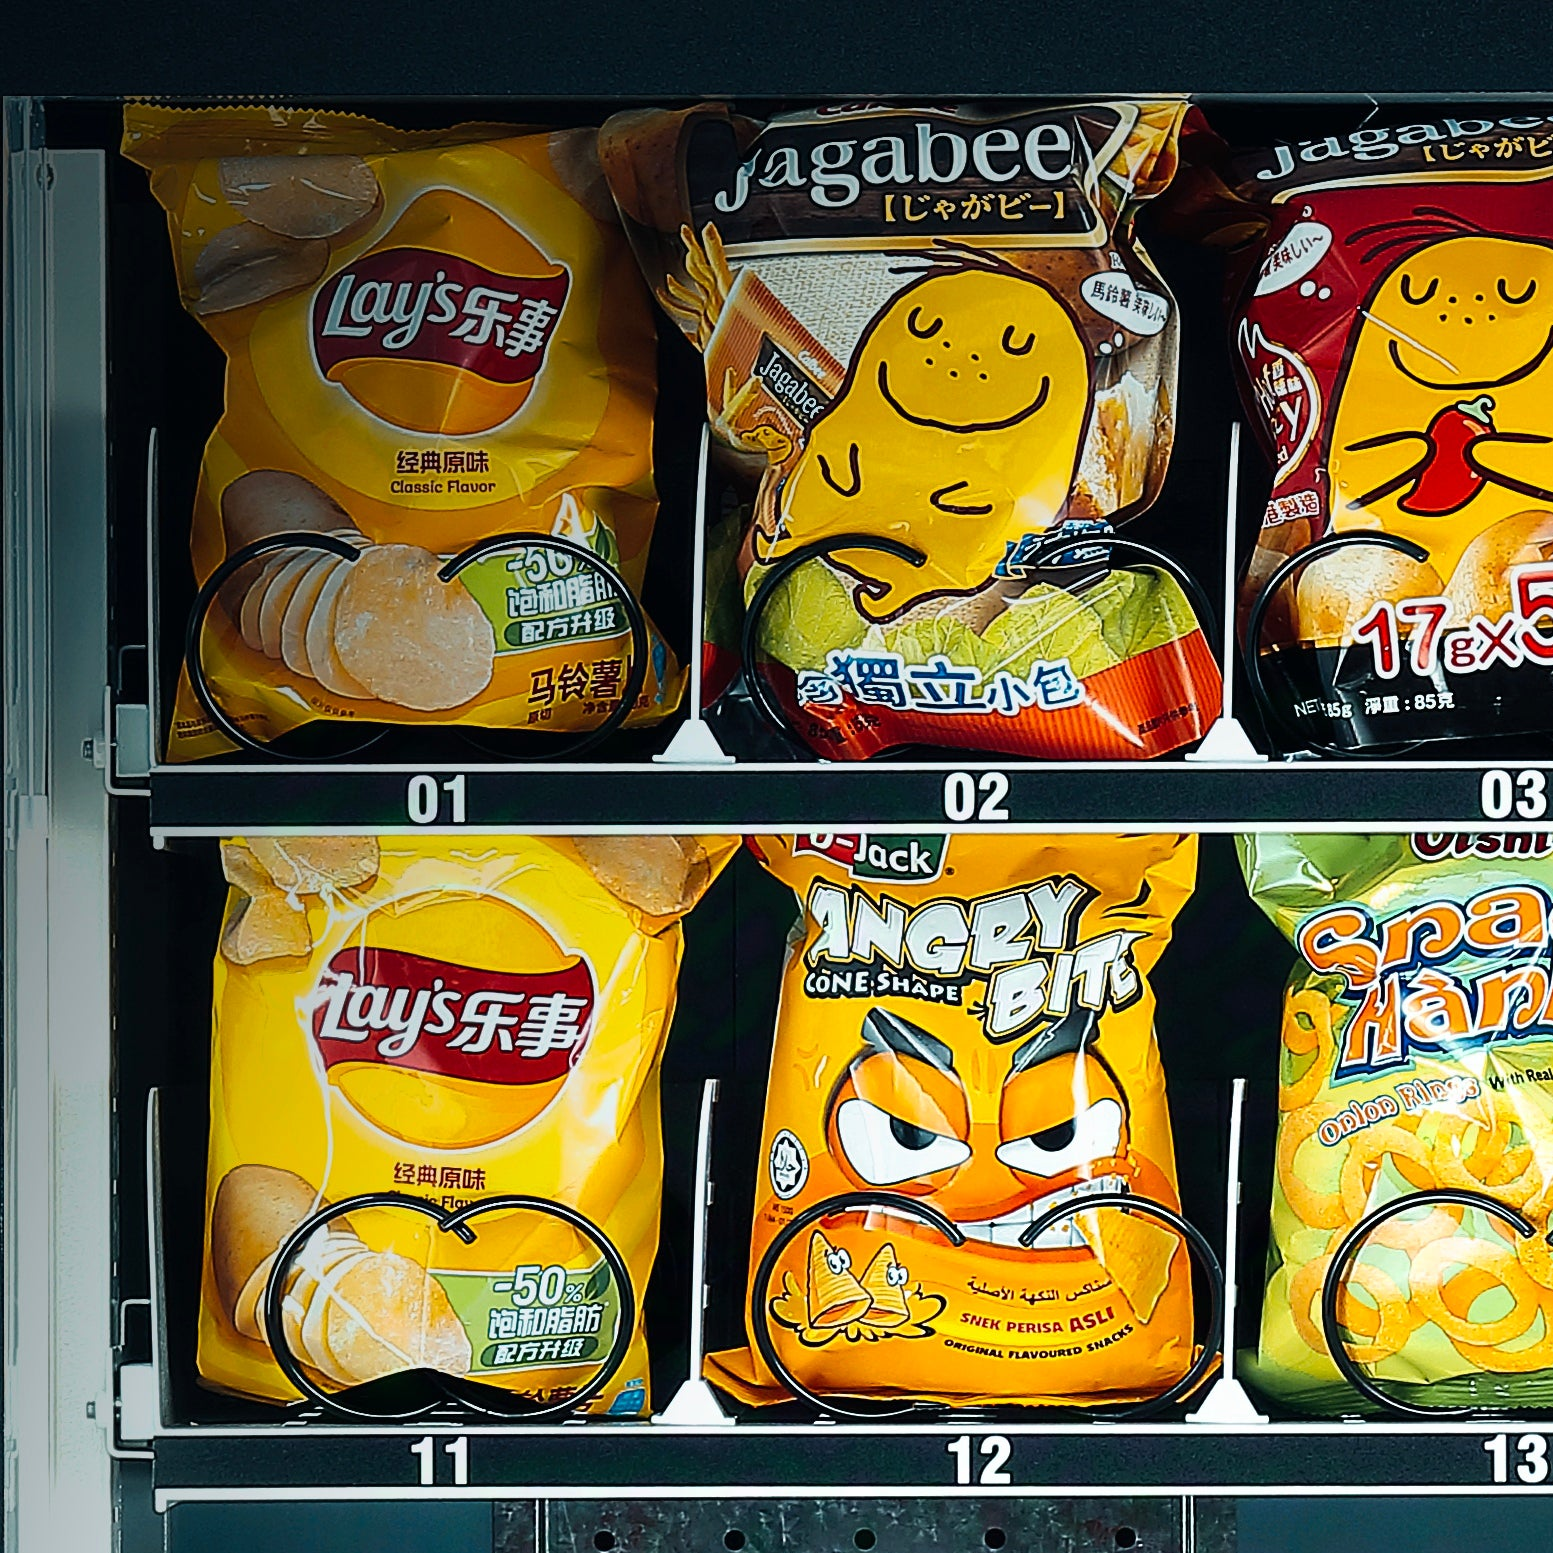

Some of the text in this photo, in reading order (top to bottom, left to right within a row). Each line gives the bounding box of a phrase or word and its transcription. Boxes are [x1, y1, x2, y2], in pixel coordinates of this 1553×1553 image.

[714, 122, 1075, 214] Jagabee
[321, 270, 558, 358] Lay's 乐事
[397, 450, 489, 474] 经典原味
[391, 480, 496, 494] Classic Flavor
[521, 608, 615, 643] 配方升级
[409, 775, 465, 823] 01
[945, 772, 1008, 820] 02
[1482, 770, 1546, 818] 03
[808, 878, 1084, 976] ANGRY
[320, 978, 587, 1057] Lay's 乐事
[1319, 1096, 1396, 1147] Onion
[1400, 1075, 1479, 1120] Rings
[394, 1163, 486, 1191] 经典原味
[493, 1266, 584, 1307] -50%
[488, 1305, 602, 1339] 饱和脂肪
[943, 1323, 1134, 1360] ORIGINAL FLAVOURED SNACKS
[960, 1306, 1116, 1334] SNEK PERISA ASLI
[495, 1338, 584, 1364] 配方升级
[412, 1437, 467, 1484] 11
[948, 1436, 1010, 1484] 12
[1485, 1434, 1548, 1482] 13
